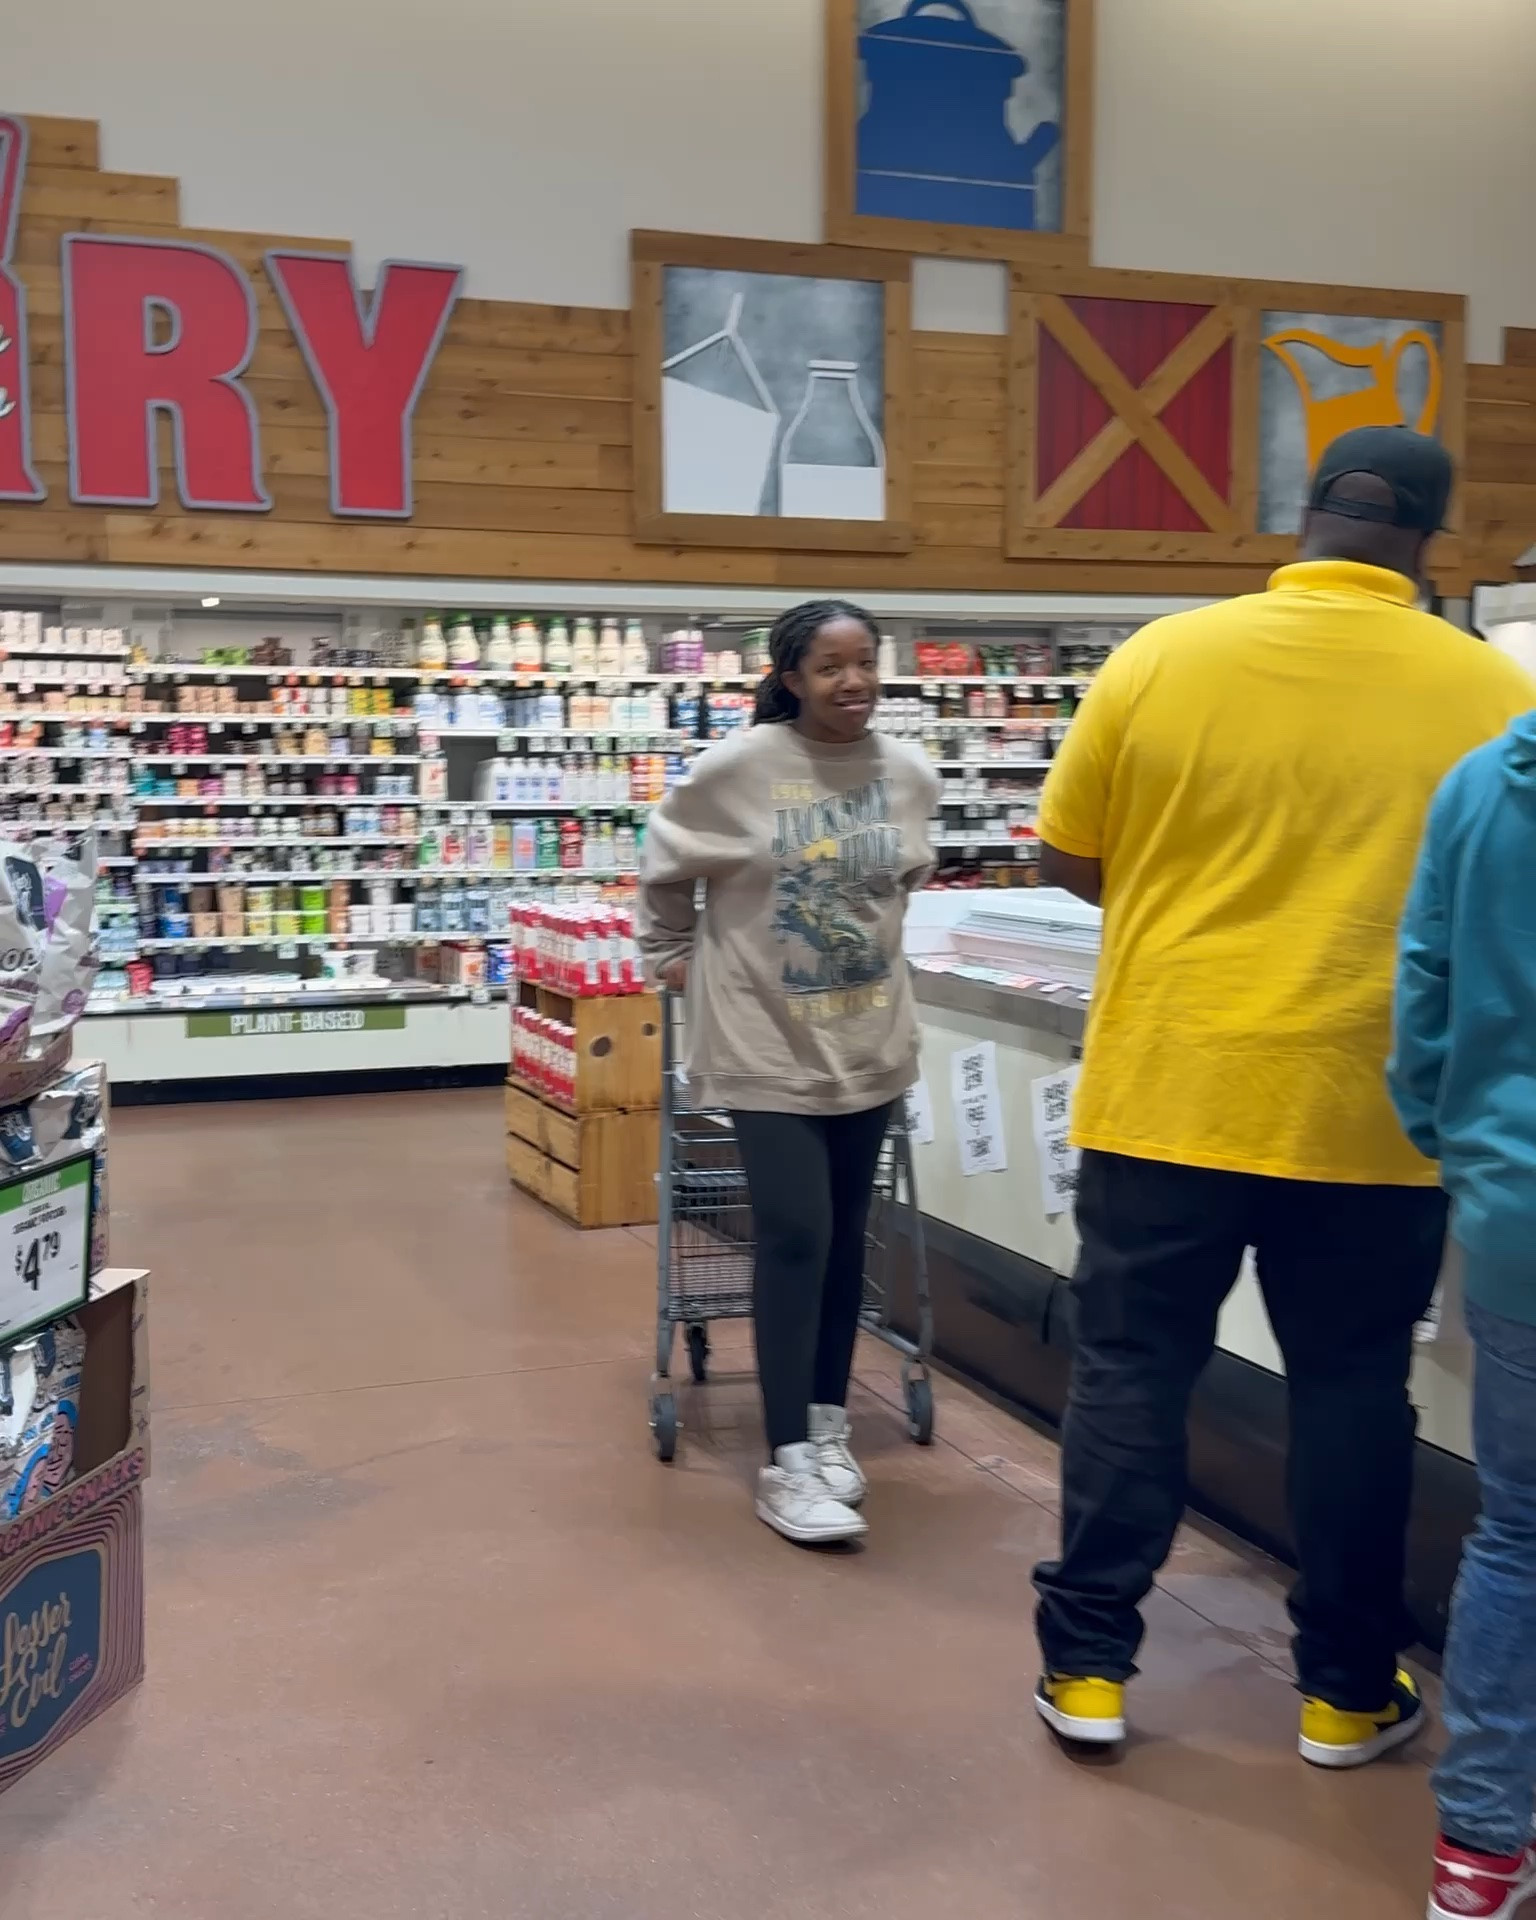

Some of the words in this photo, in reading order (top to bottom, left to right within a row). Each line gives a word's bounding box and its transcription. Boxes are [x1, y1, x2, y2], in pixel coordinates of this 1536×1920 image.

[0, 113, 464, 518] RY
[230, 1010, 366, 1035] PLANT-BASED
[11, 1632, 68, 1728] Evil
